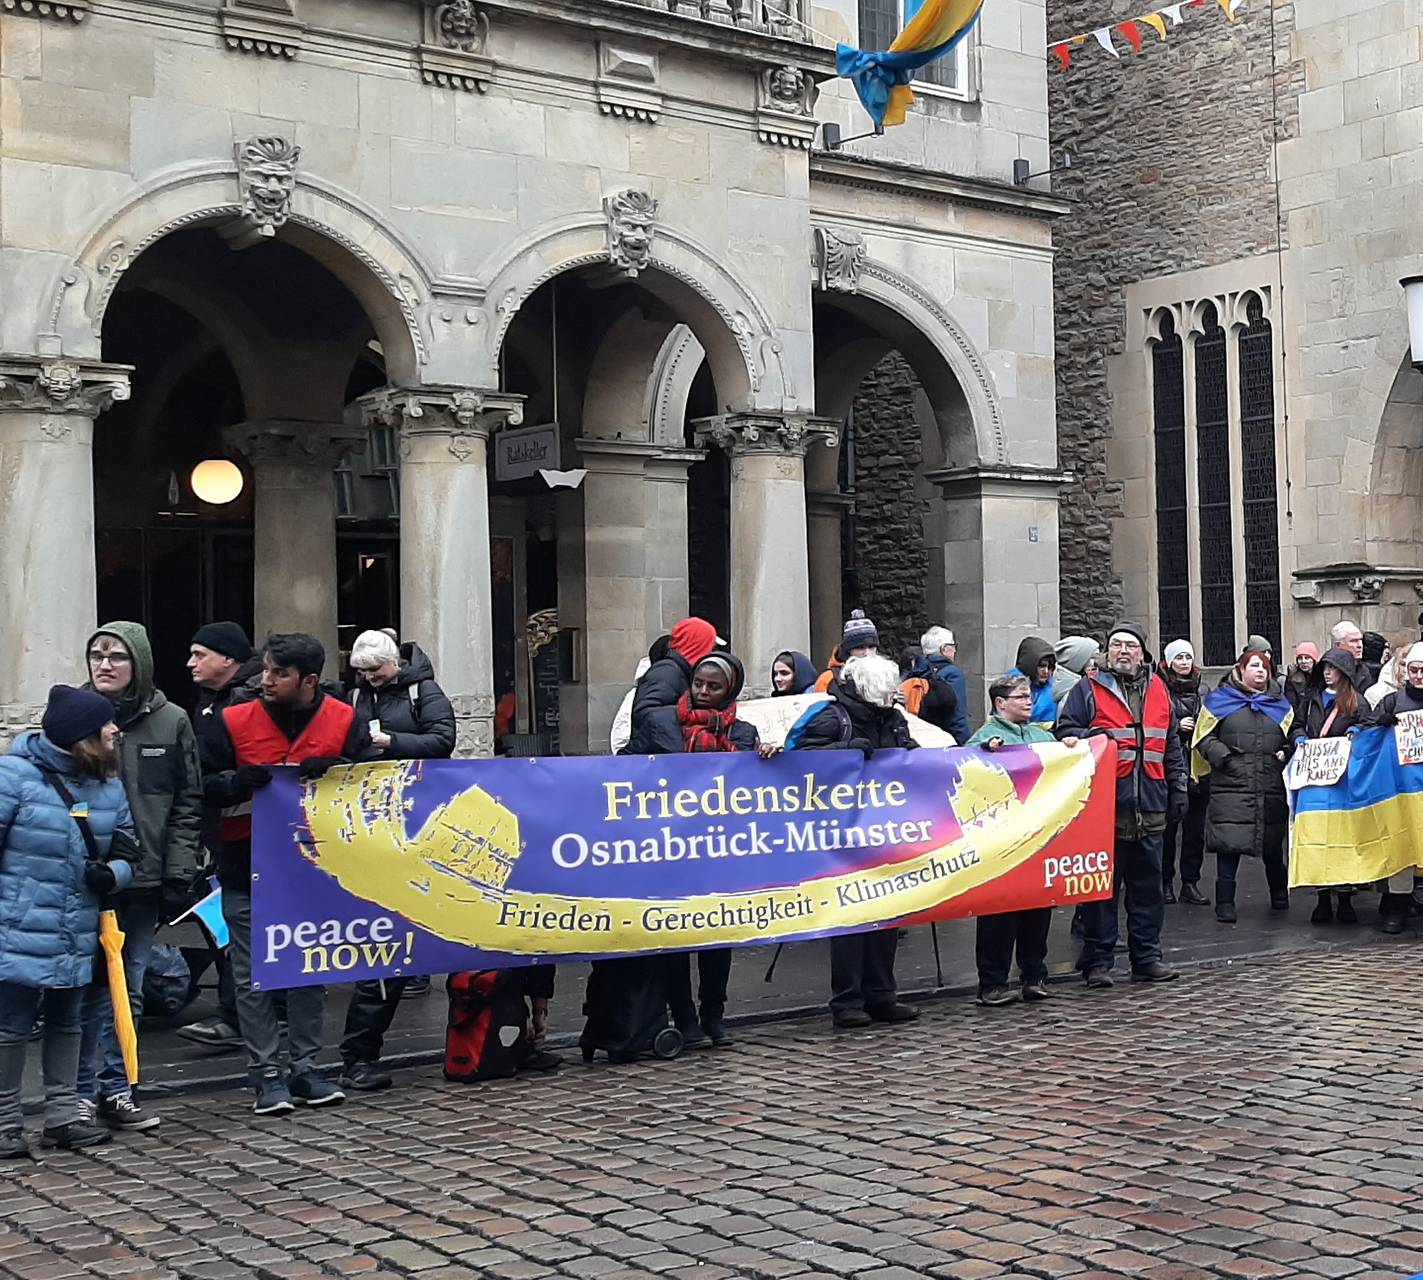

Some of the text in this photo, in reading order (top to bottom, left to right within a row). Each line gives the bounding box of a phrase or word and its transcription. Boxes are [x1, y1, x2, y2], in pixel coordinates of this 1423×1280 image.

[1303, 740, 1340, 759] RUSSIA
[1307, 768, 1338, 783] RAPES
[602, 773, 907, 821] Friedenskette
[552, 819, 932, 869] Osnabrück-Münster
[1044, 850, 1109, 888] peace
[1064, 871, 1112, 897] now
[496, 901, 612, 932] Frieden
[642, 893, 813, 932] Gerechtigkeit
[836, 849, 980, 907] Klimaschutz
[264, 916, 394, 963] peace
[302, 931, 415, 973] now!
